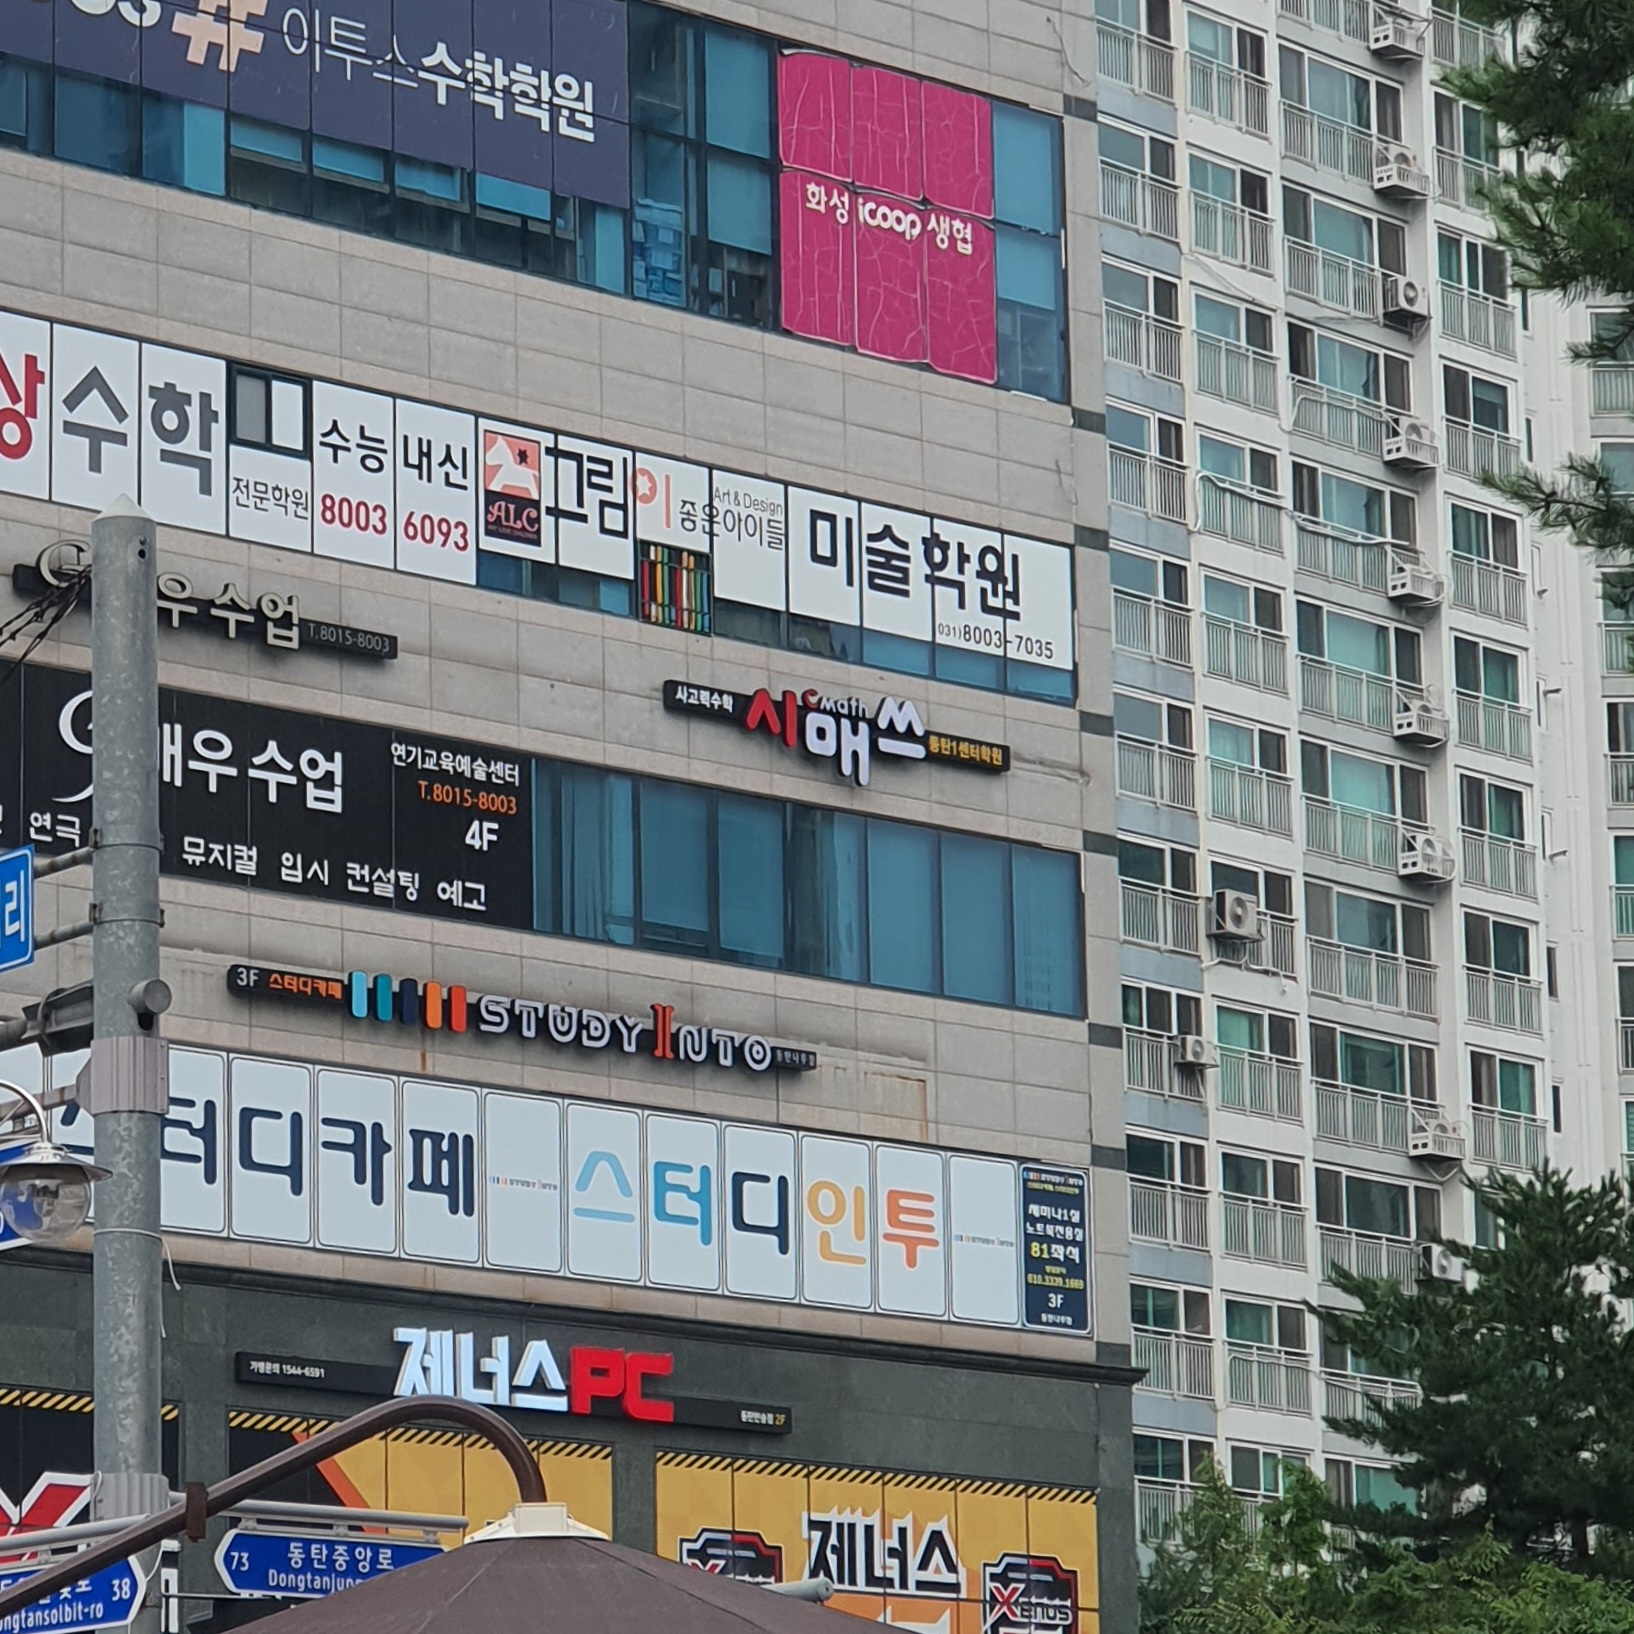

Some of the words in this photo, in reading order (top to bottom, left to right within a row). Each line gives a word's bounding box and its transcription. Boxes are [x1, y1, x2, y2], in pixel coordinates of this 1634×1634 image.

[805, 181, 850, 225] 화성
[927, 213, 973, 256] 생협
[319, 418, 388, 474] 수능
[403, 433, 469, 492] 내신
[232, 476, 309, 520] 전문학원
[713, 486, 732, 506] Art
[743, 492, 784, 518] Design
[320, 493, 388, 536] 8003
[403, 510, 470, 552] 6093
[486, 500, 539, 533] ALC
[809, 508, 1021, 622] 미술학원
[307, 622, 391, 655] T.8015-8003
[675, 685, 734, 714] 사고력수학
[746, 687, 927, 787] 시매쓰
[390, 742, 520, 787] 연기교육예술센터
[417, 780, 518, 815] T.8015-8003
[465, 819, 500, 852] 4F
[29, 811, 82, 848] 연극
[182, 835, 258, 876] 뮤지컬
[280, 852, 330, 886] 입시
[346, 861, 420, 902] 컨설팅
[436, 878, 487, 912] 예고
[236, 966, 259, 987] 3F
[268, 973, 343, 1000] 스터디카페
[60, 1096, 475, 1218] 터디카페
[573, 1150, 941, 1270] 스터디인투
[1048, 1293, 1065, 1309] 3F
[281, 1363, 326, 1379] 1544-6591
[230, 1551, 250, 1572] 73
[288, 1542, 395, 1574] 동탄중앙로
[805, 1511, 964, 1597] 제너스
[111, 1577, 132, 1602] 38
